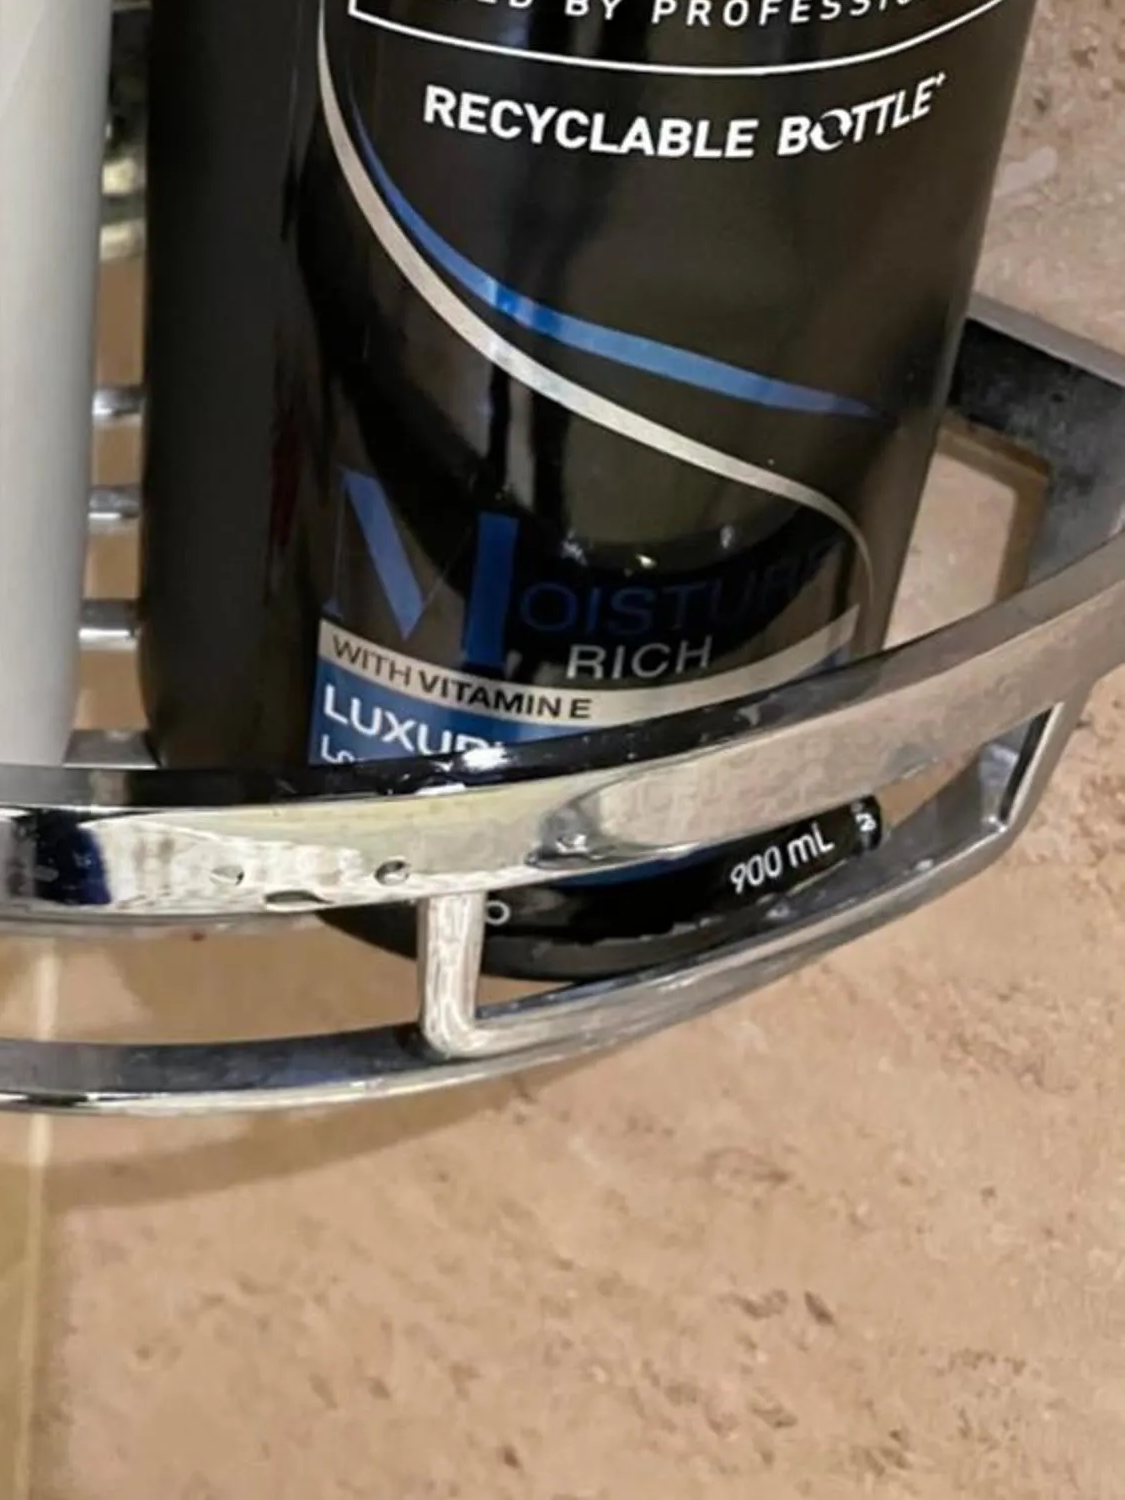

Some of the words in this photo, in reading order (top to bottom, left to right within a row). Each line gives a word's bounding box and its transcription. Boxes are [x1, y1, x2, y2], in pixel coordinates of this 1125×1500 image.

[422, 84, 759, 160] RECYCLABLE
[332, 635, 412, 688] WITH
[418, 669, 562, 719] VITAMIN
[568, 697, 593, 720] E
[566, 636, 714, 680] RICH
[730, 845, 784, 895] 900
[787, 821, 836, 869] mL
